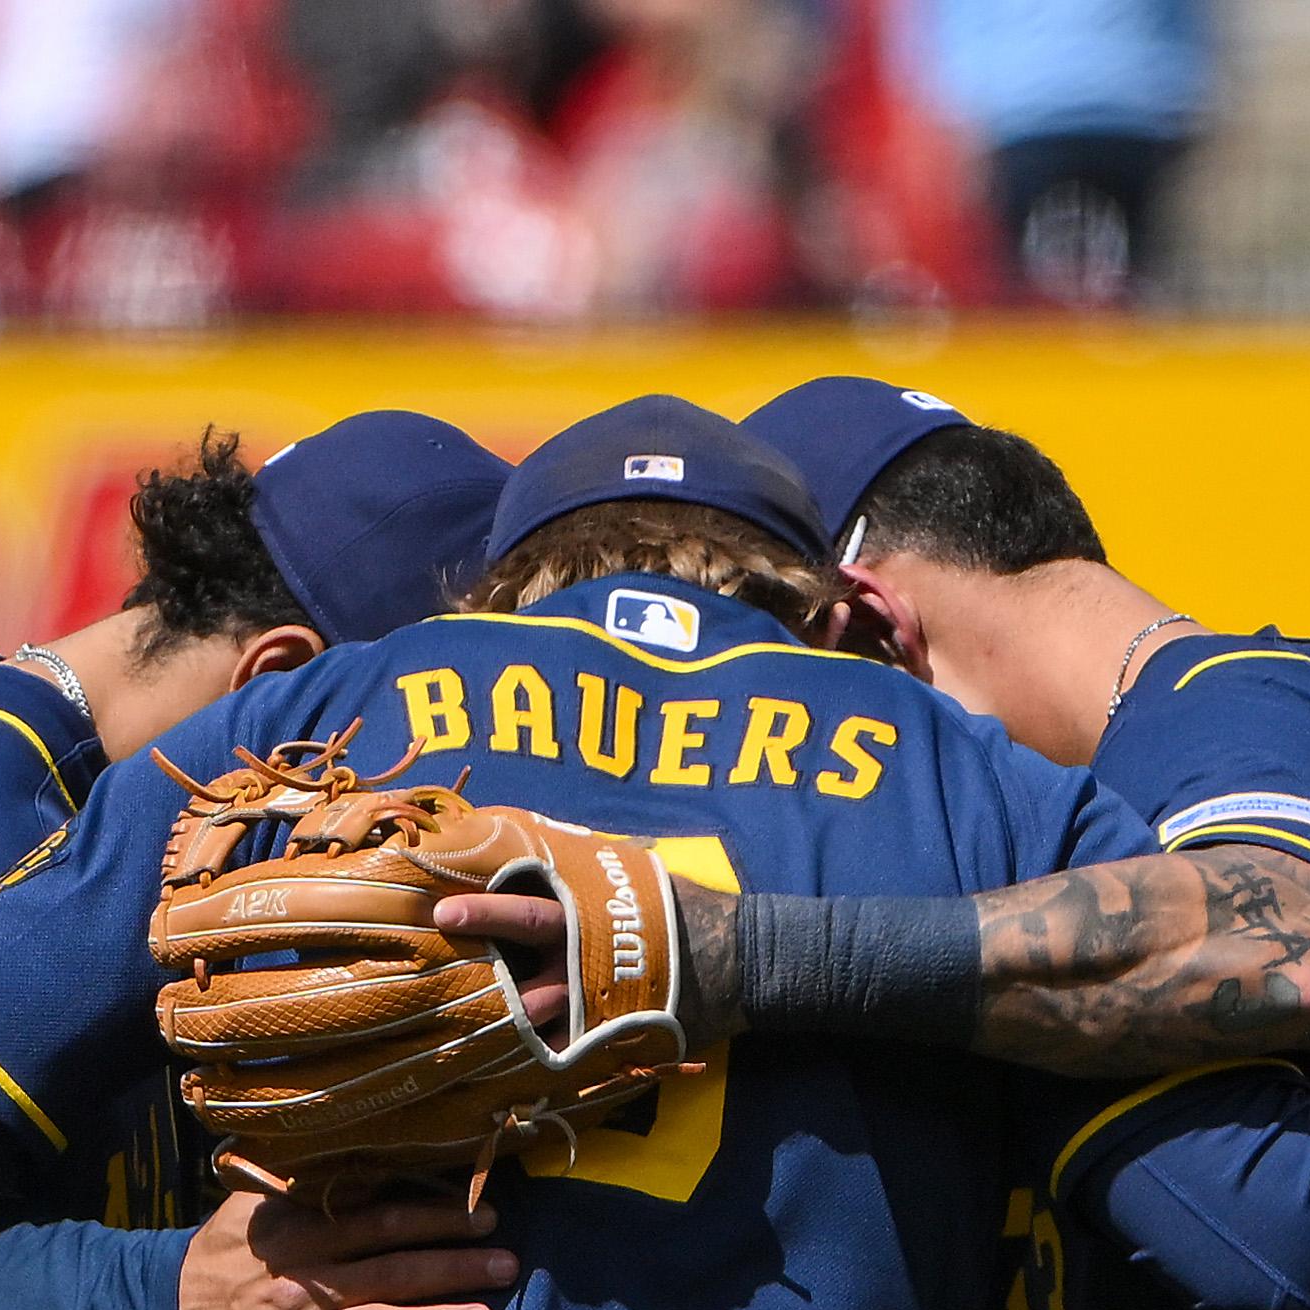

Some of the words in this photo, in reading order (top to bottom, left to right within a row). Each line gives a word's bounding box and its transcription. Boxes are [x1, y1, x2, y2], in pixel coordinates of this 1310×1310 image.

[395, 664, 899, 800] BAUERS
[220, 888, 293, 924] A2K
[594, 846, 648, 983] Wilson
